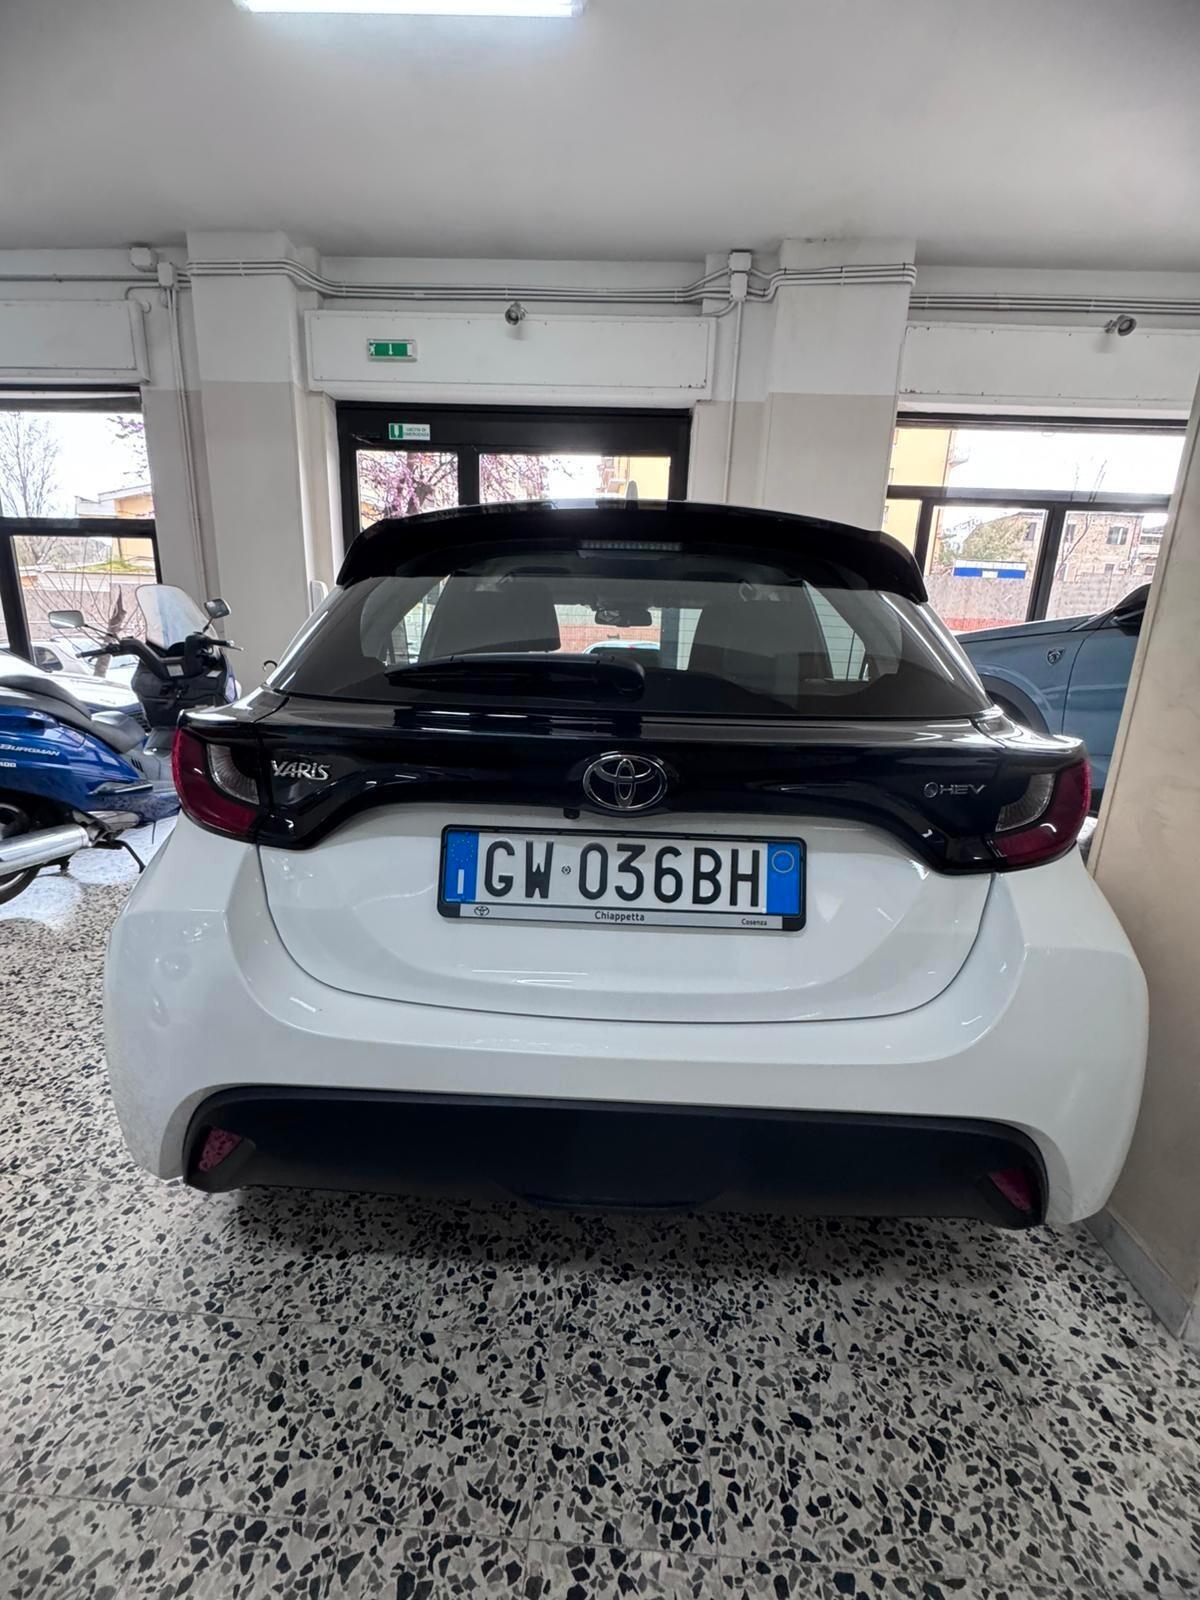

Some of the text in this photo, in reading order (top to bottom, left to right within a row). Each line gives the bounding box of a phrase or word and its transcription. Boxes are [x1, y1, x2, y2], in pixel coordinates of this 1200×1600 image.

[940, 784, 986, 795] HEV
[484, 840, 760, 907] GW 036BH
[594, 911, 645, 922] Chiappetta
[741, 918, 767, 926] Cosenza
